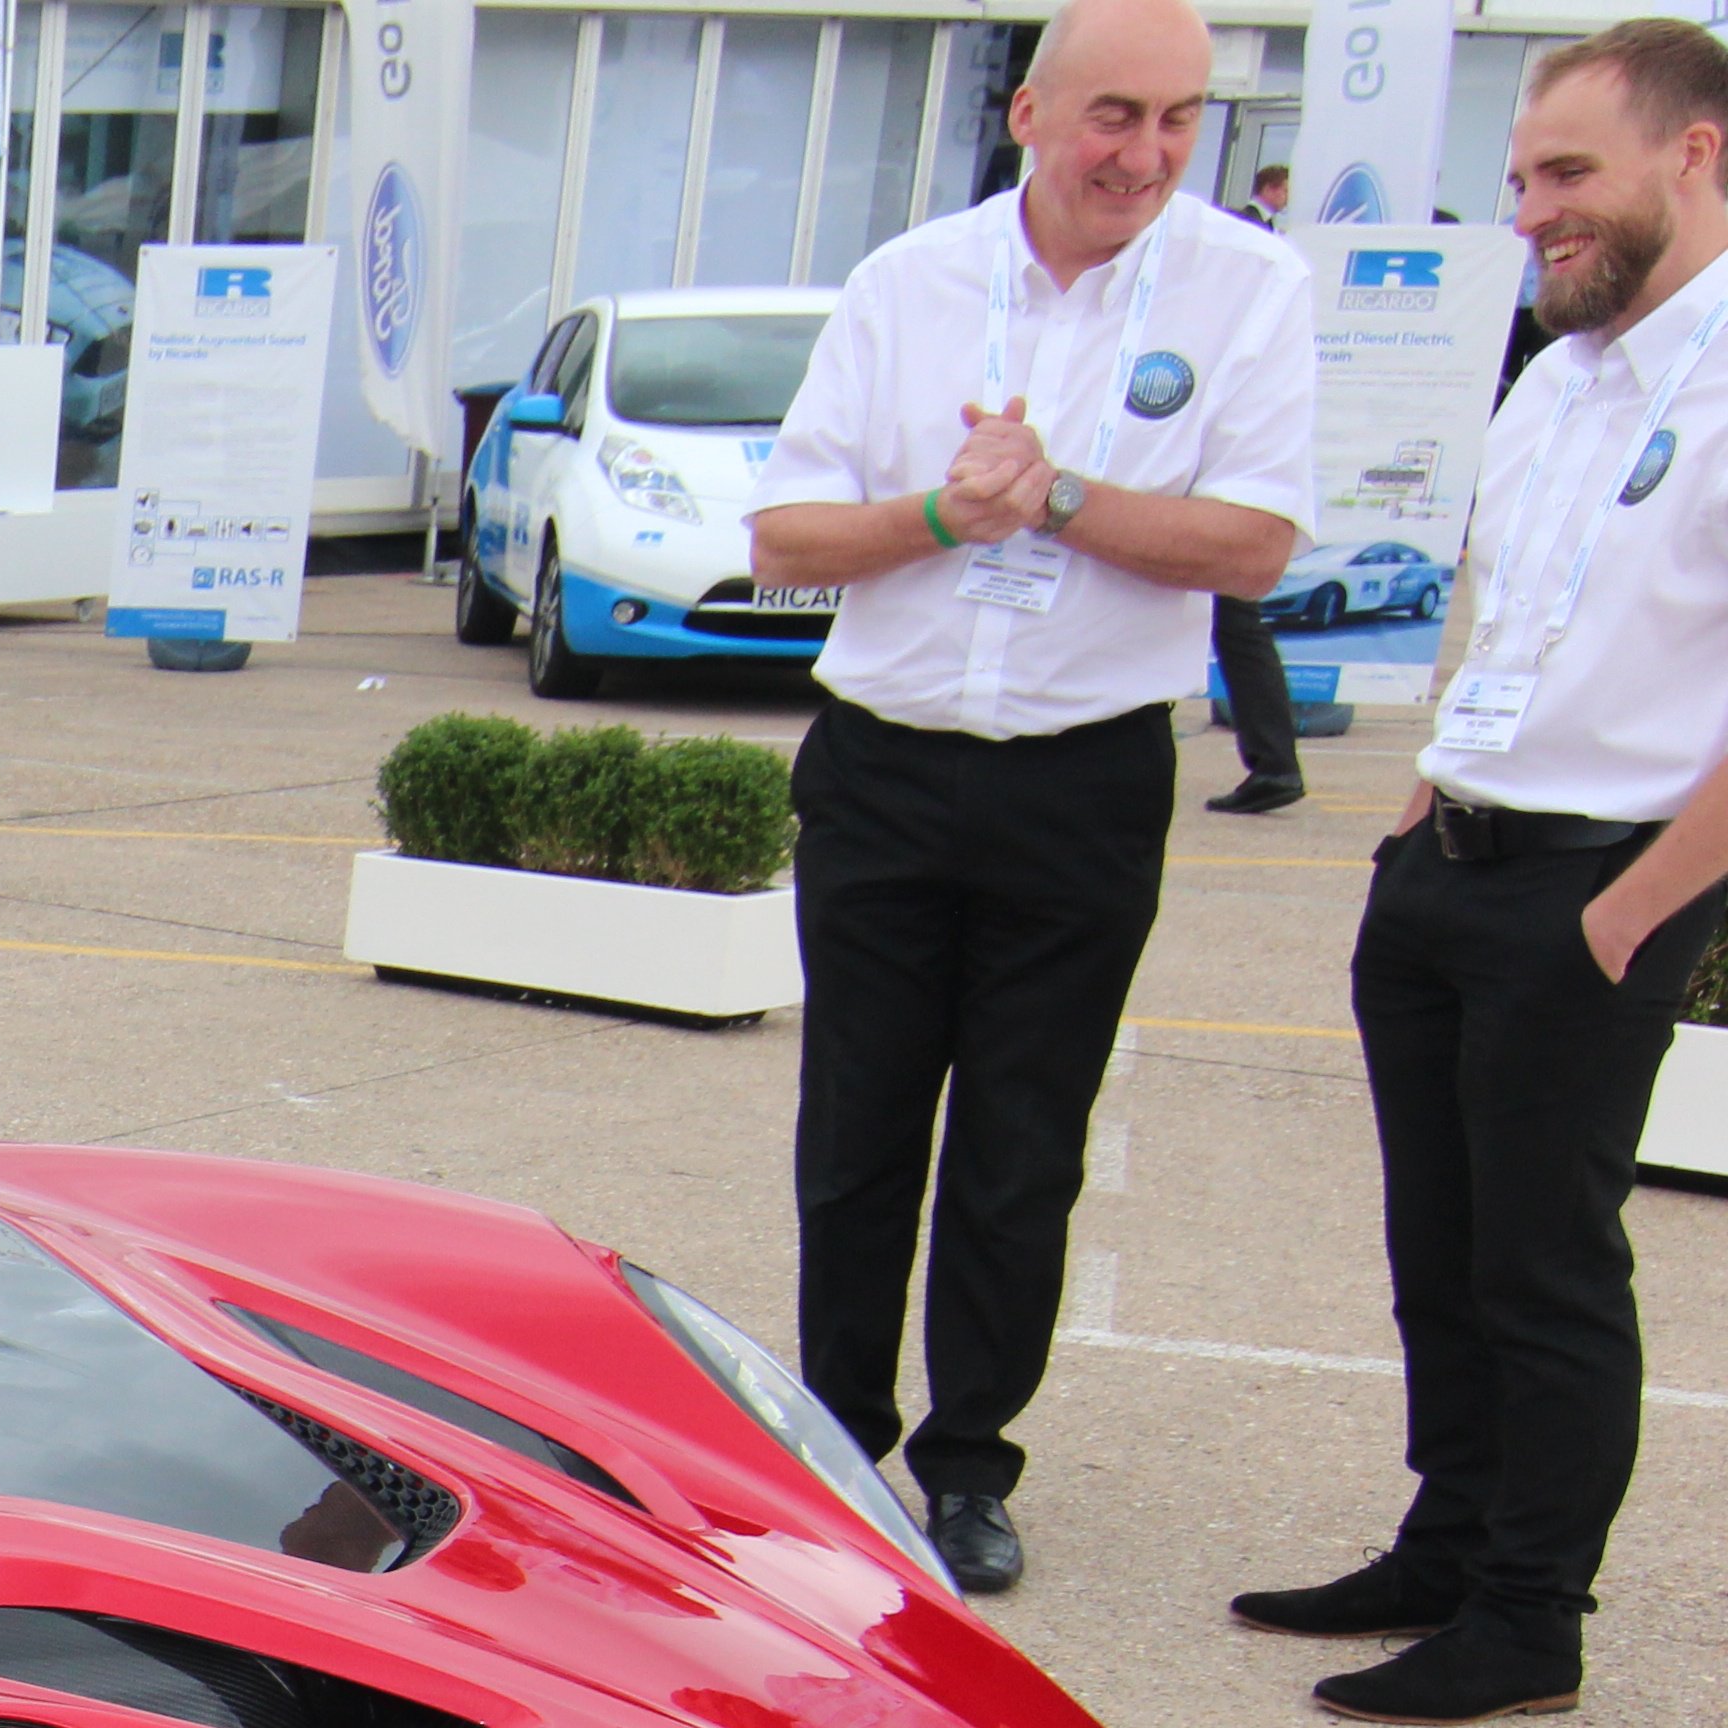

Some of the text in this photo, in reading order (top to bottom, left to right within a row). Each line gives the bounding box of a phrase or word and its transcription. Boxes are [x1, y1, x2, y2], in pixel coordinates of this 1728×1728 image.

[1342, 291, 1433, 309] RICARDO
[1353, 332, 1398, 346] Diesel
[1401, 332, 1455, 347] Electric
[149, 347, 209, 361] by Ricardo
[219, 568, 285, 586] RAS-R
